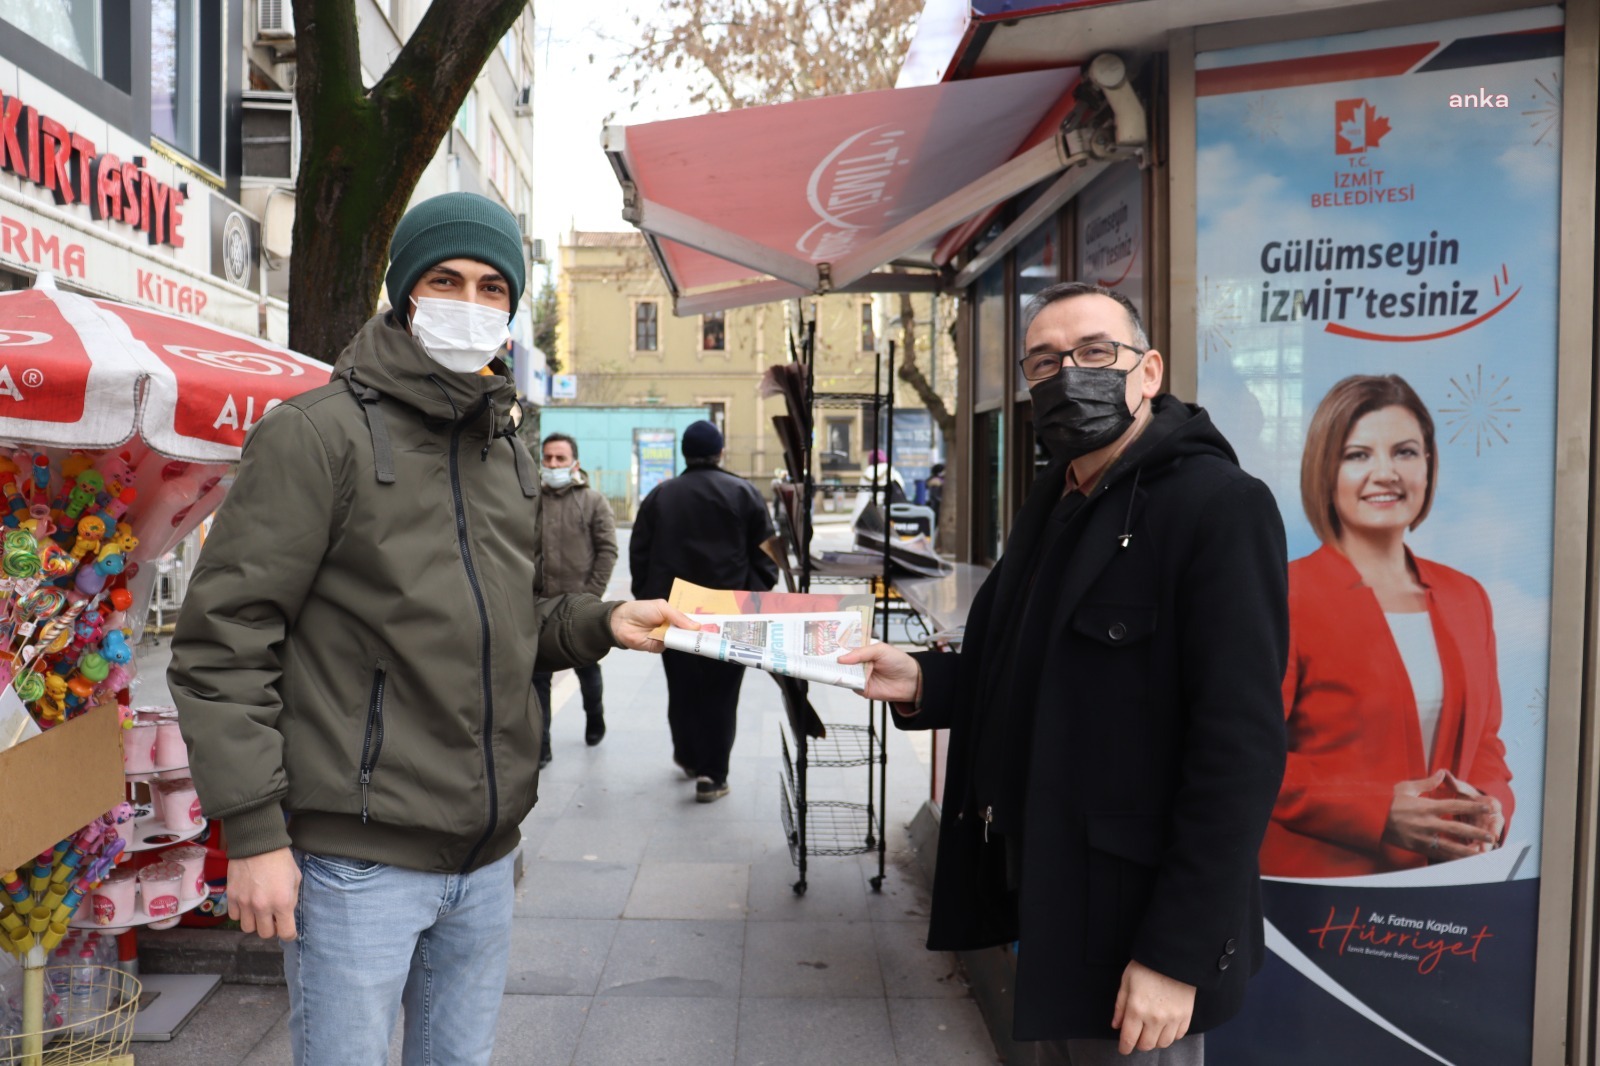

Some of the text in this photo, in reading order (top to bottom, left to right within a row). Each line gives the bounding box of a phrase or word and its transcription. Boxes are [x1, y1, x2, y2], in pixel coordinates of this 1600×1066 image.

[1349, 156, 1370, 167] T.C.
[1310, 184, 1415, 208] BELEDİYESİ
[1334, 170, 1384, 188] İZMİT
[1260, 230, 1459, 276] Gülümseyin
[137, 268, 208, 316] KİTAP
[1260, 278, 1479, 323] İZMİT'tesiniz
[1308, 905, 1494, 975] Hürriyet
[1369, 912, 1468, 936] Av. Fatma Kaplan
